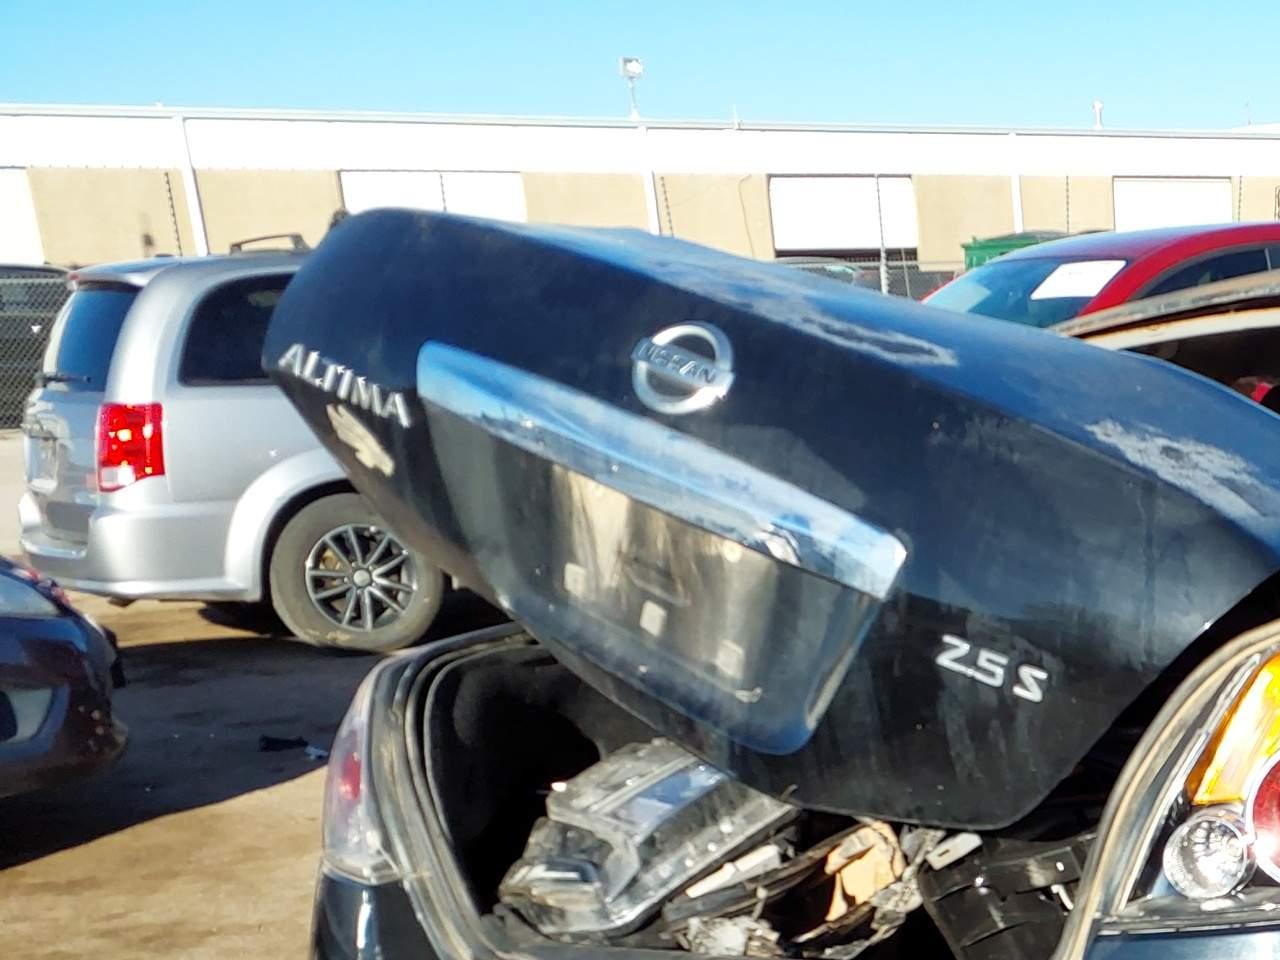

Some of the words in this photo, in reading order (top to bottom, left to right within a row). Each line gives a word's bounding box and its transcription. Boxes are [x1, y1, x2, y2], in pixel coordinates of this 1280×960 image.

[637, 341, 717, 384] NISSAN
[278, 344, 411, 428] ALTIMA
[1012, 663, 1048, 703] S
